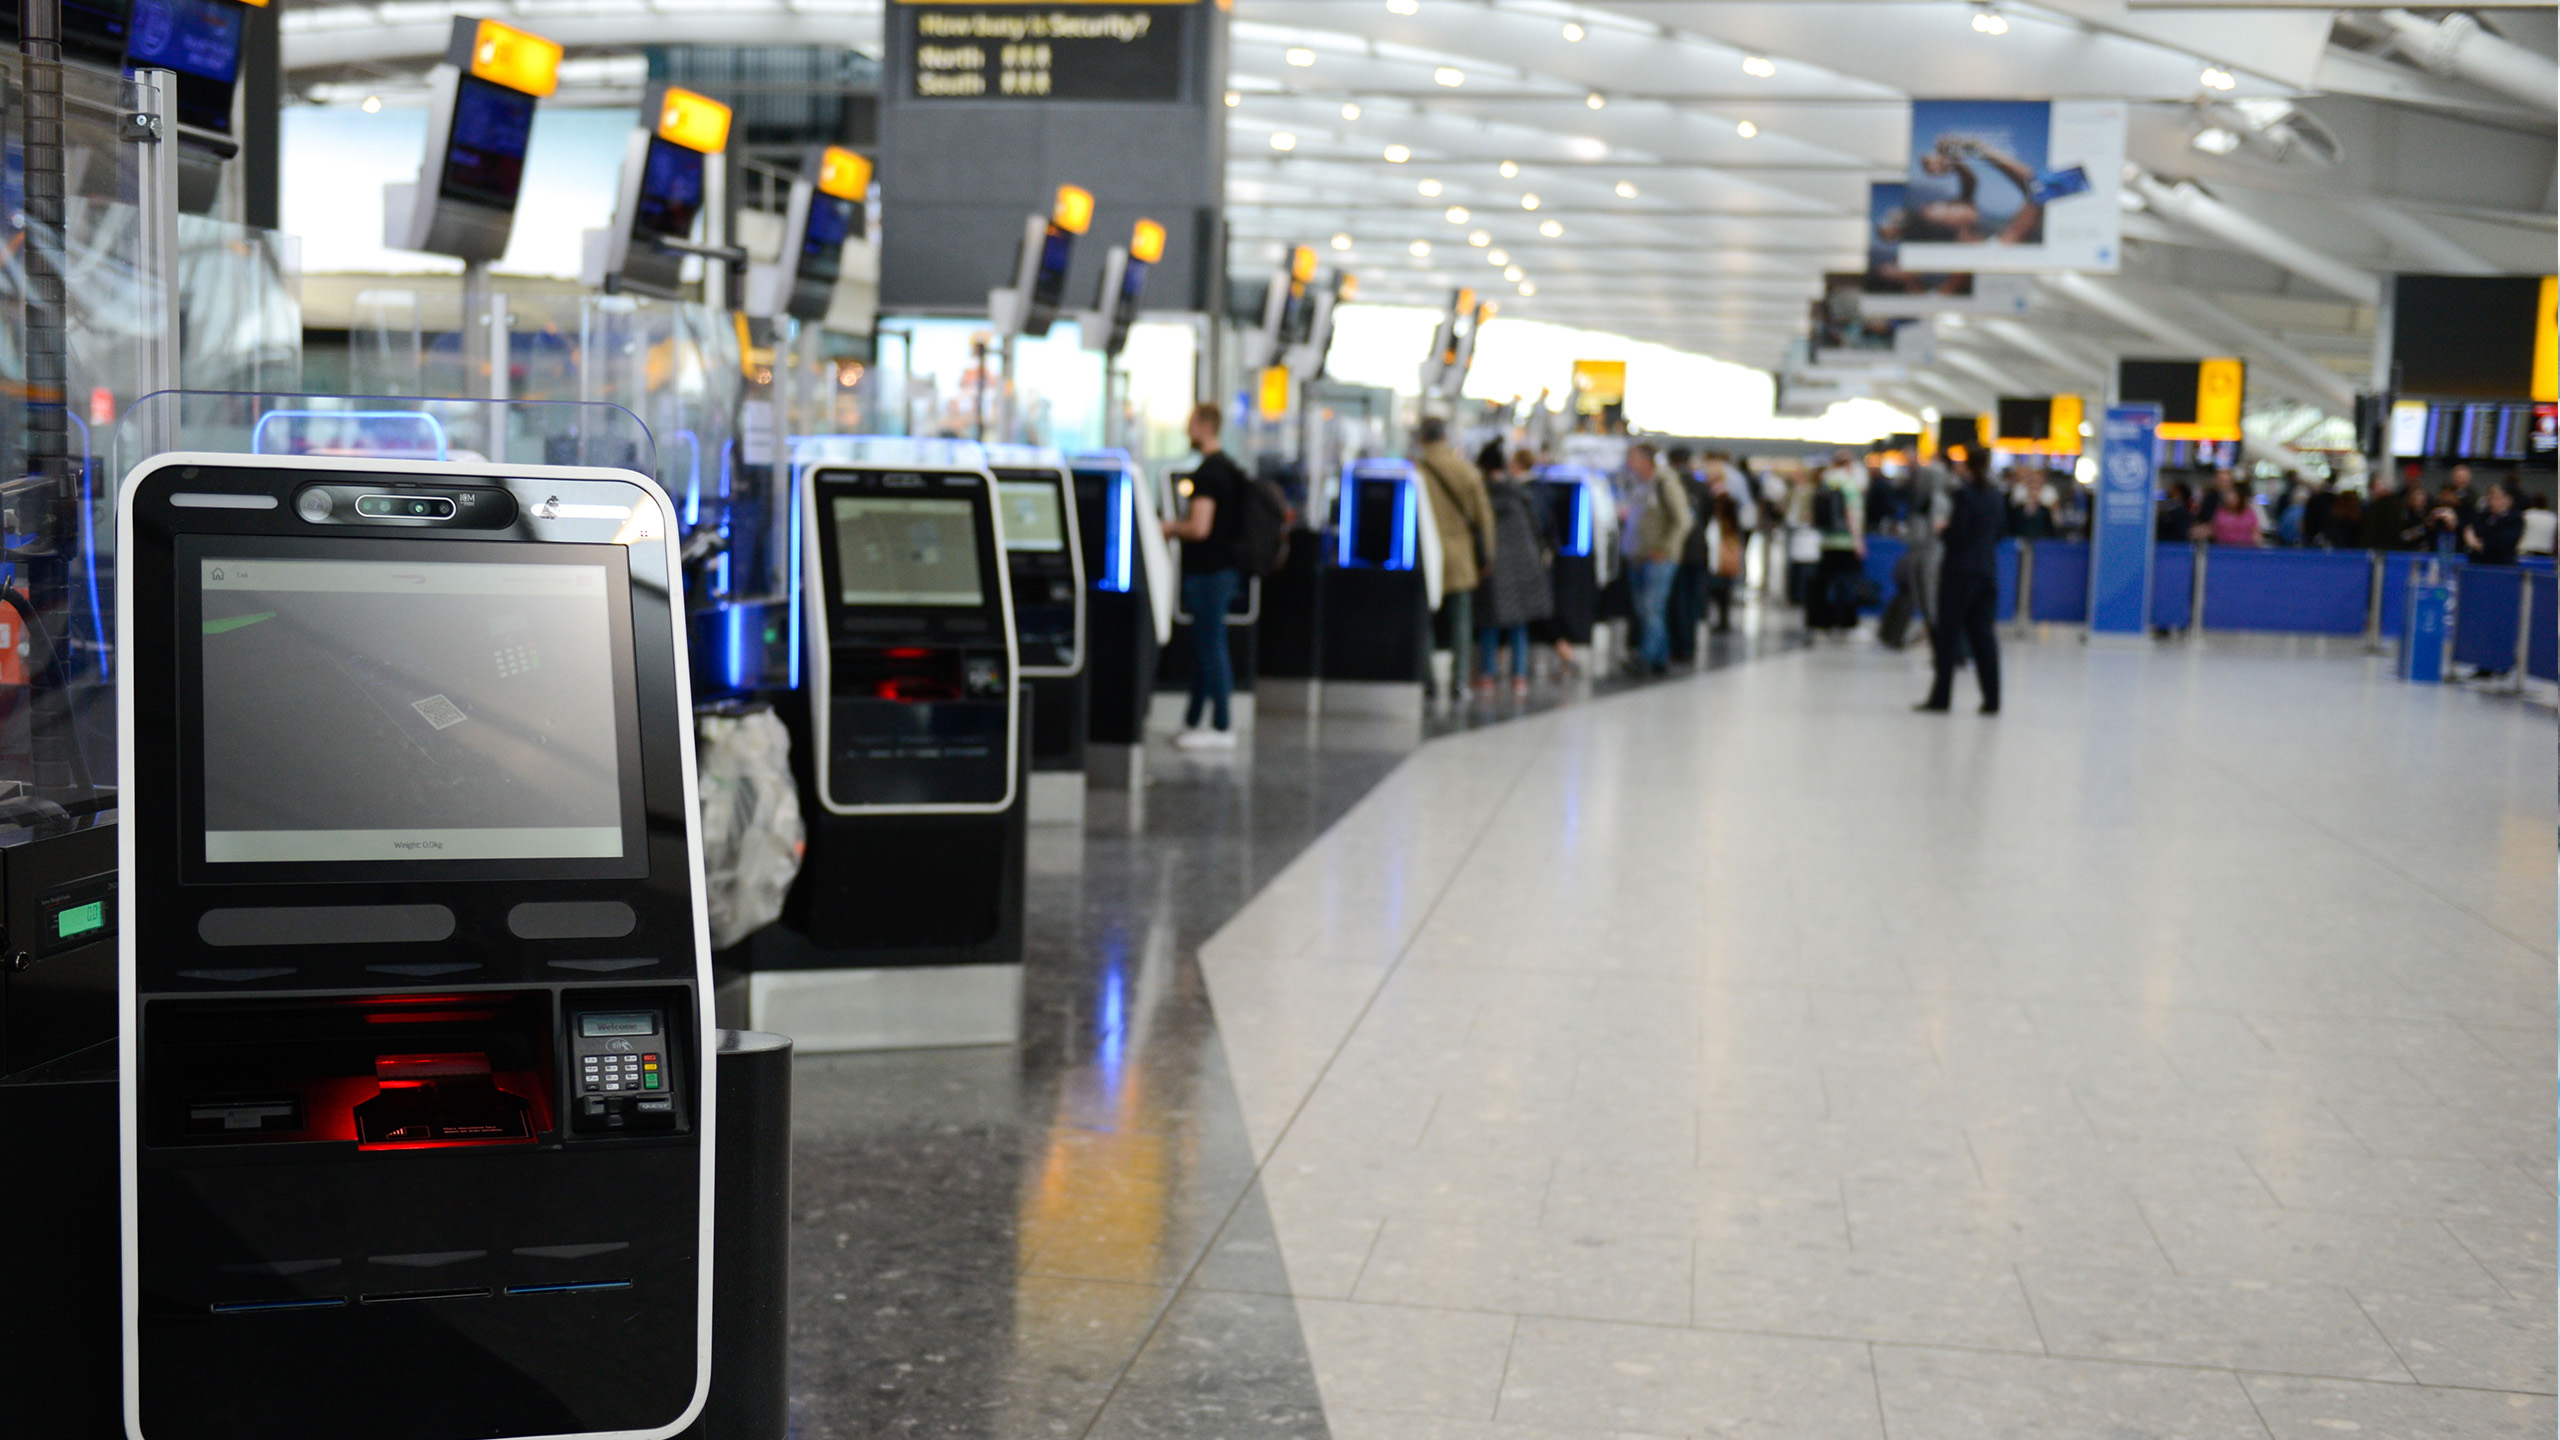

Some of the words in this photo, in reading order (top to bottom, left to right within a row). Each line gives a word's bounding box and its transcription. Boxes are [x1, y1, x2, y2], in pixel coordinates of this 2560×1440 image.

[919, 13, 972, 37] How
[973, 13, 1025, 42] busy
[1050, 12, 1150, 42] Security?
[918, 44, 985, 70] North
[918, 71, 985, 96] South
[597, 1022, 637, 1031] Welcome
